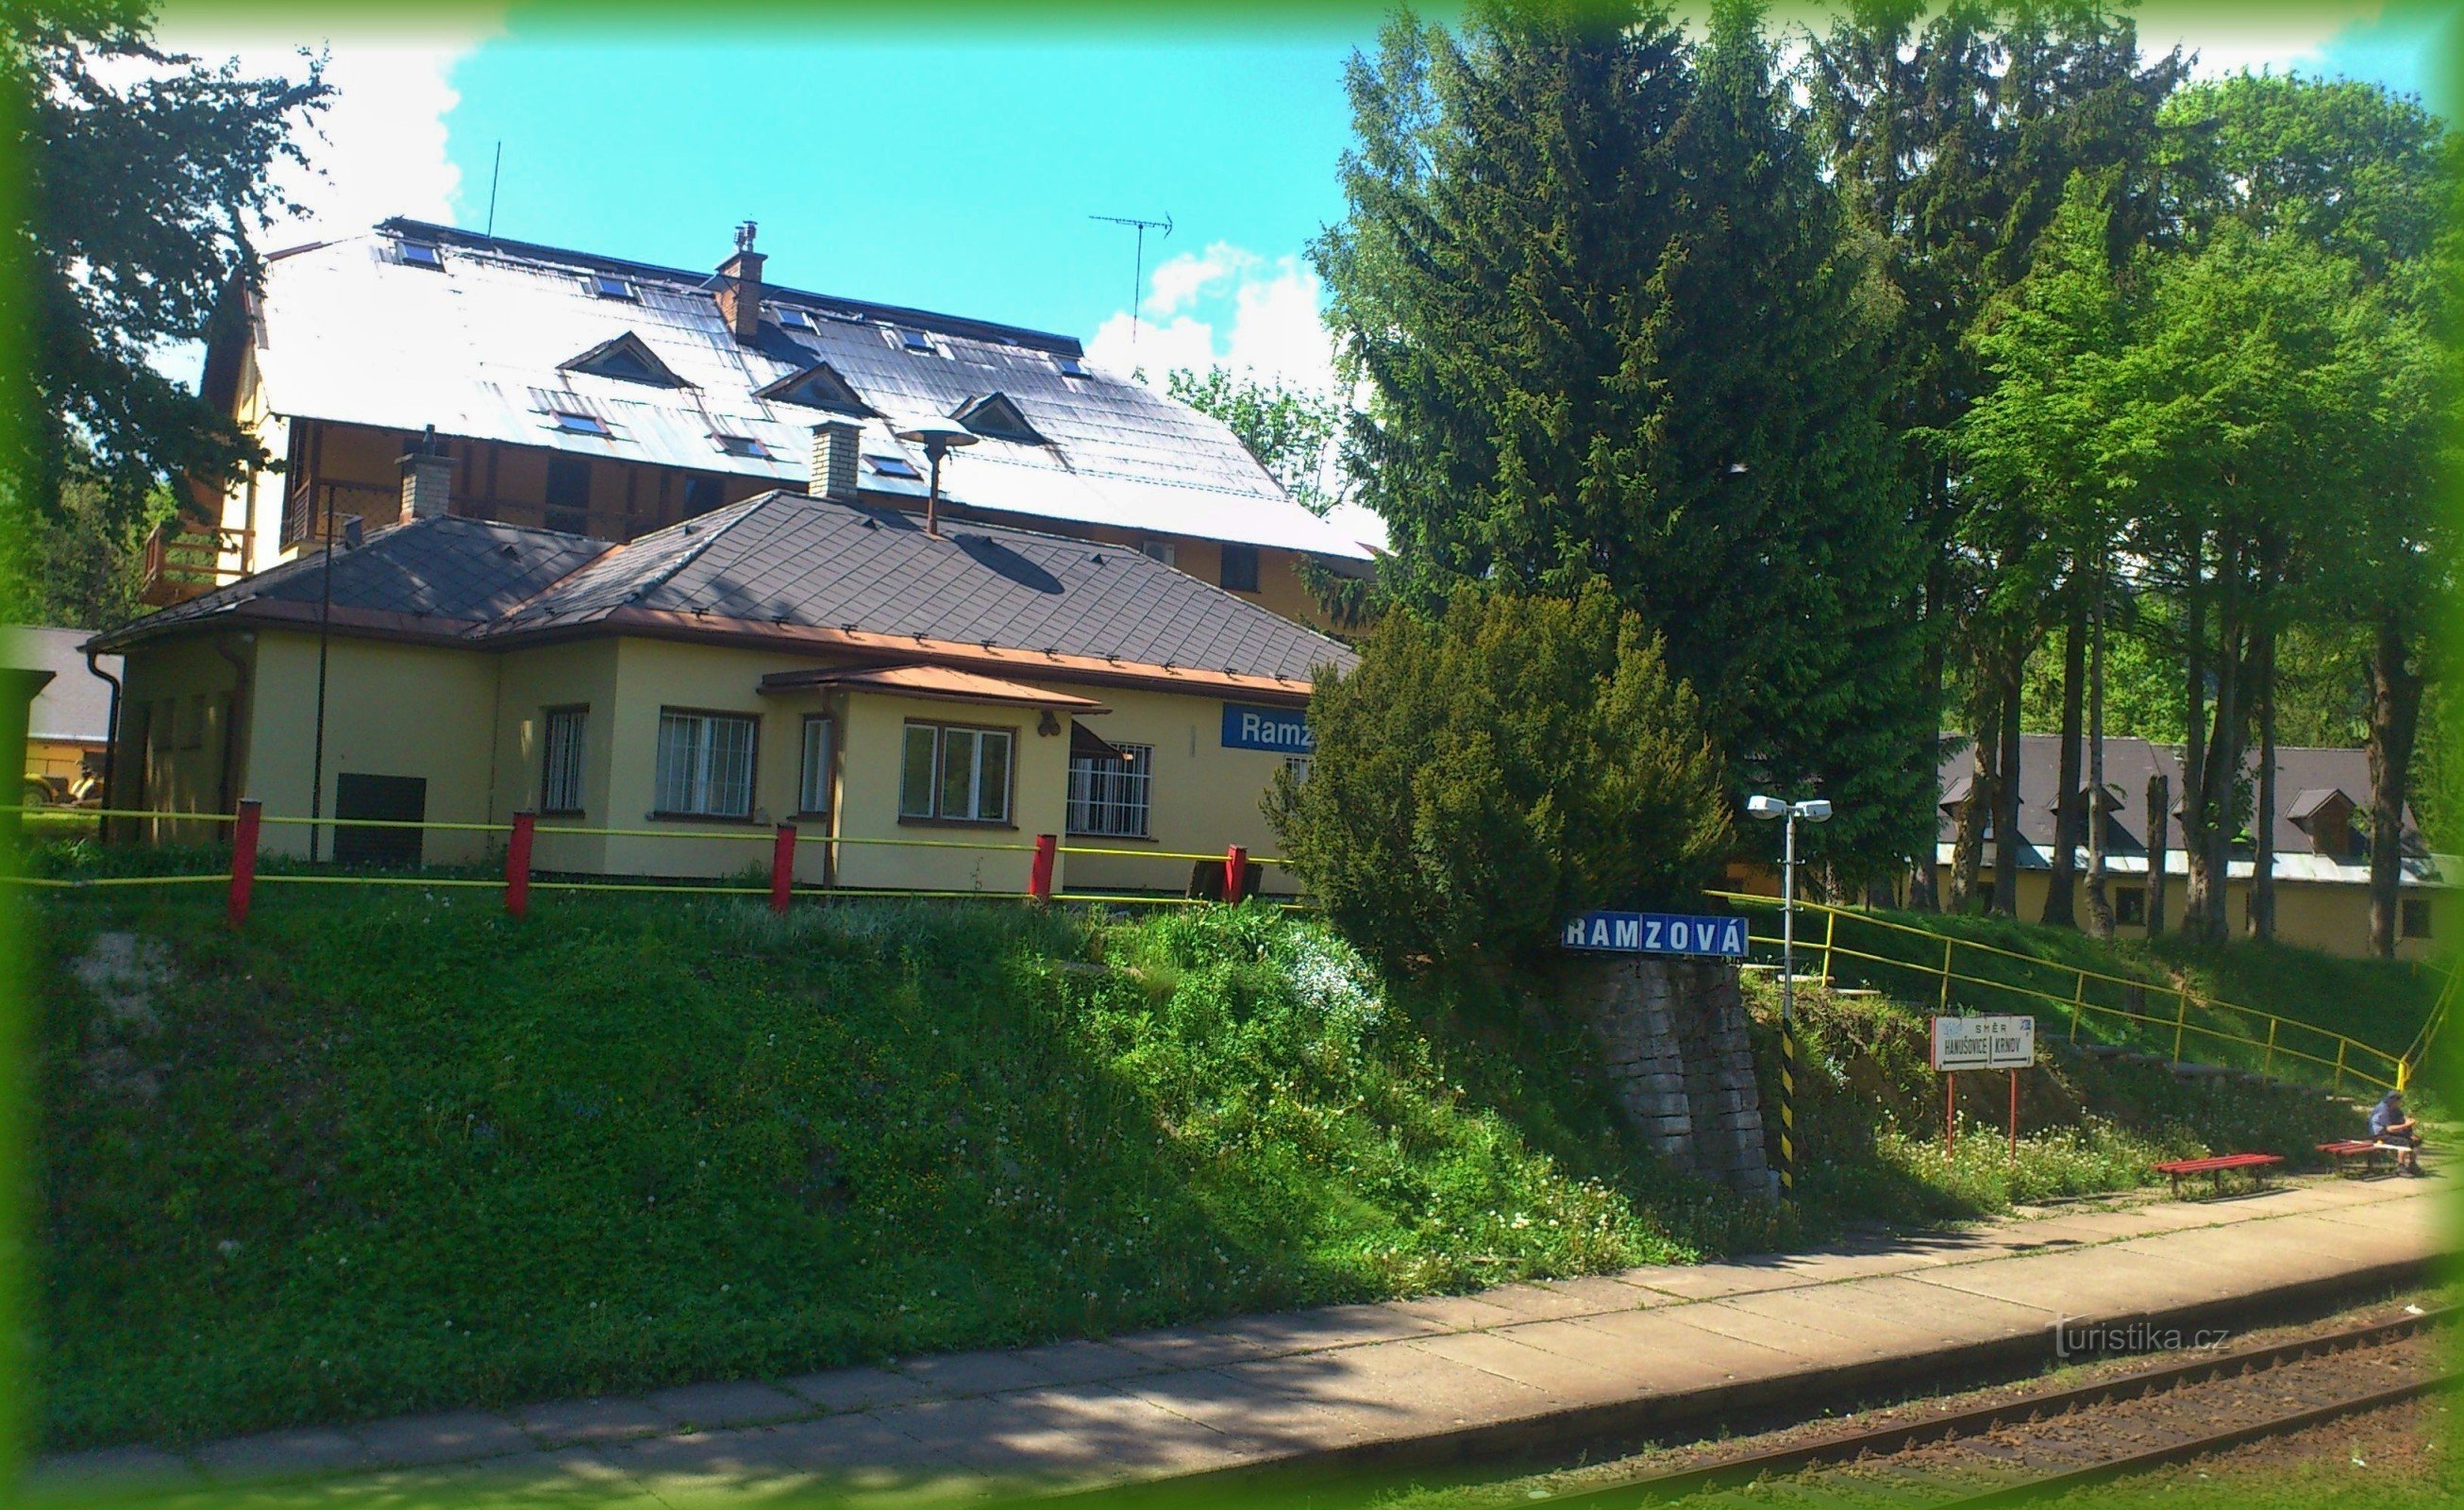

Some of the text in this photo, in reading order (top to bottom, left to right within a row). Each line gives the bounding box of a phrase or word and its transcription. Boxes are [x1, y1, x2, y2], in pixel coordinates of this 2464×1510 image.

[1567, 917, 1742, 954] RAMZOVÁ
[1975, 1022, 2007, 1034] SMĚR
[1944, 1035, 1987, 1055] HANUŠOVICE
[1994, 1037, 2021, 1054] KRNOV
